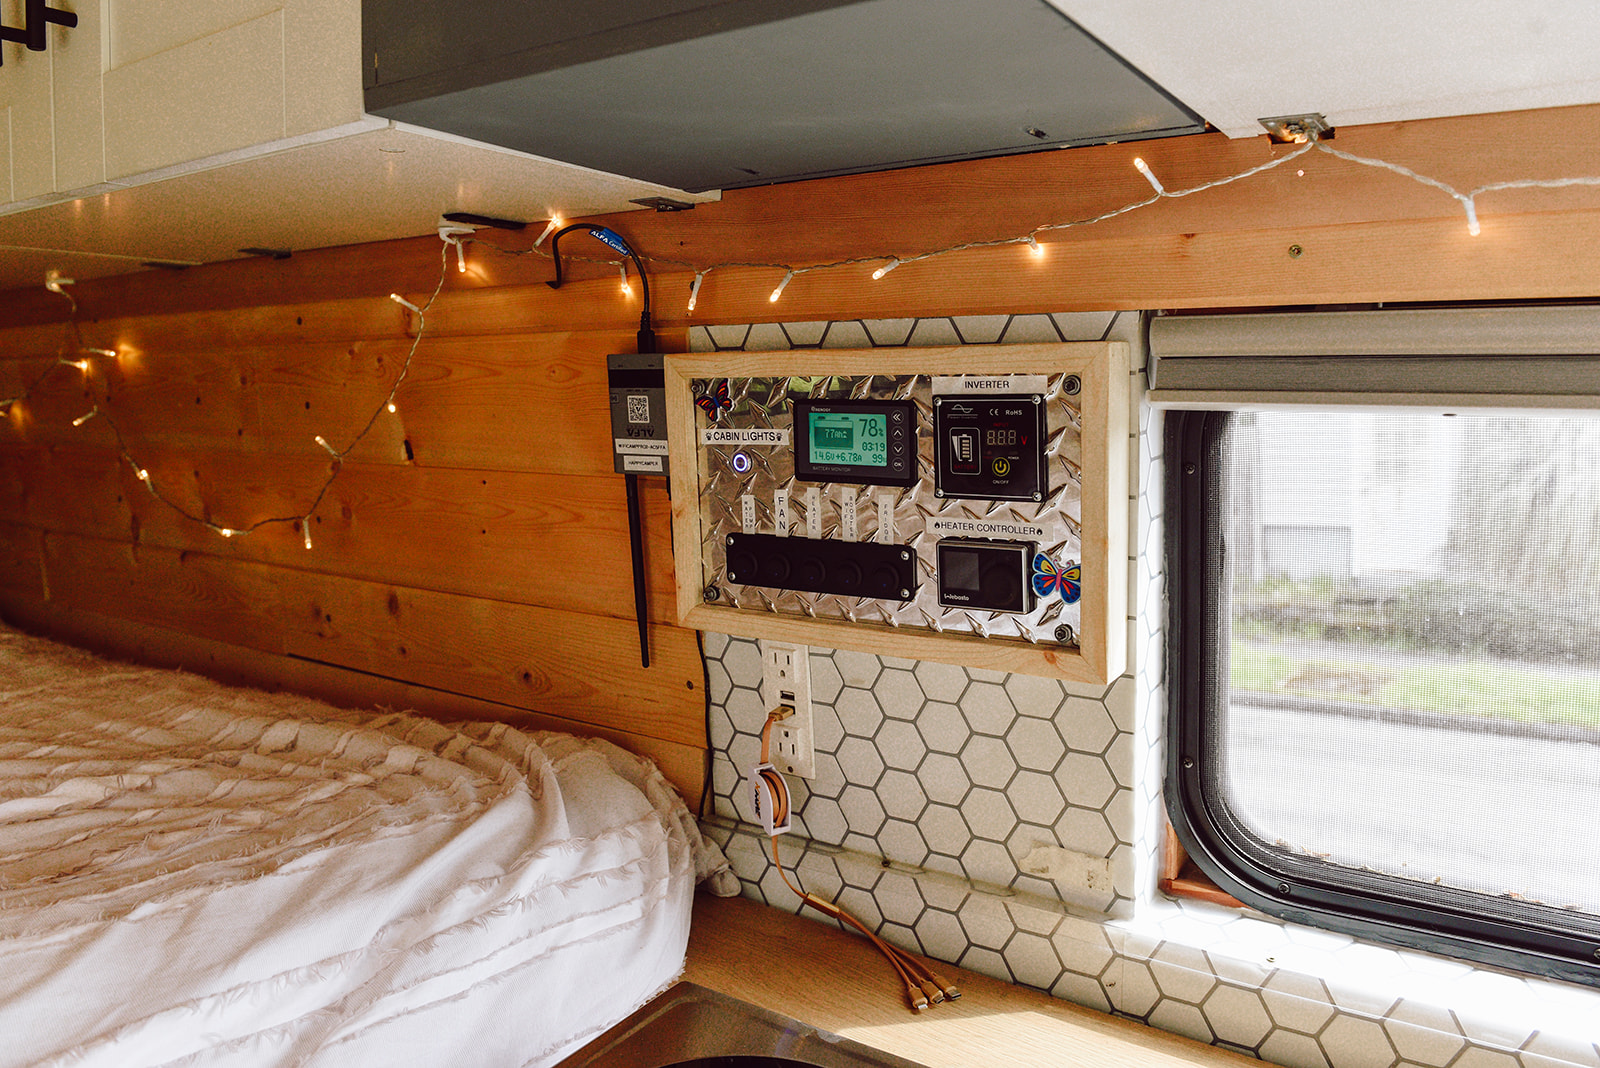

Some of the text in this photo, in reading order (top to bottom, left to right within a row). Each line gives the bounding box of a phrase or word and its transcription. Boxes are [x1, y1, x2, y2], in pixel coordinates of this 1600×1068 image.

[591, 230, 608, 243] ALFA
[964, 380, 1010, 389] INVERTER
[989, 408, 999, 416] CE
[626, 428, 655, 437] ALFA
[858, 418, 884, 437] 78%
[713, 431, 776, 442] CABIN LIGHTS
[1020, 435, 1028, 446] V
[861, 441, 886, 452] 03:19
[777, 496, 786, 530] FAN
[940, 521, 1036, 535] HEATER CONTROLLER
